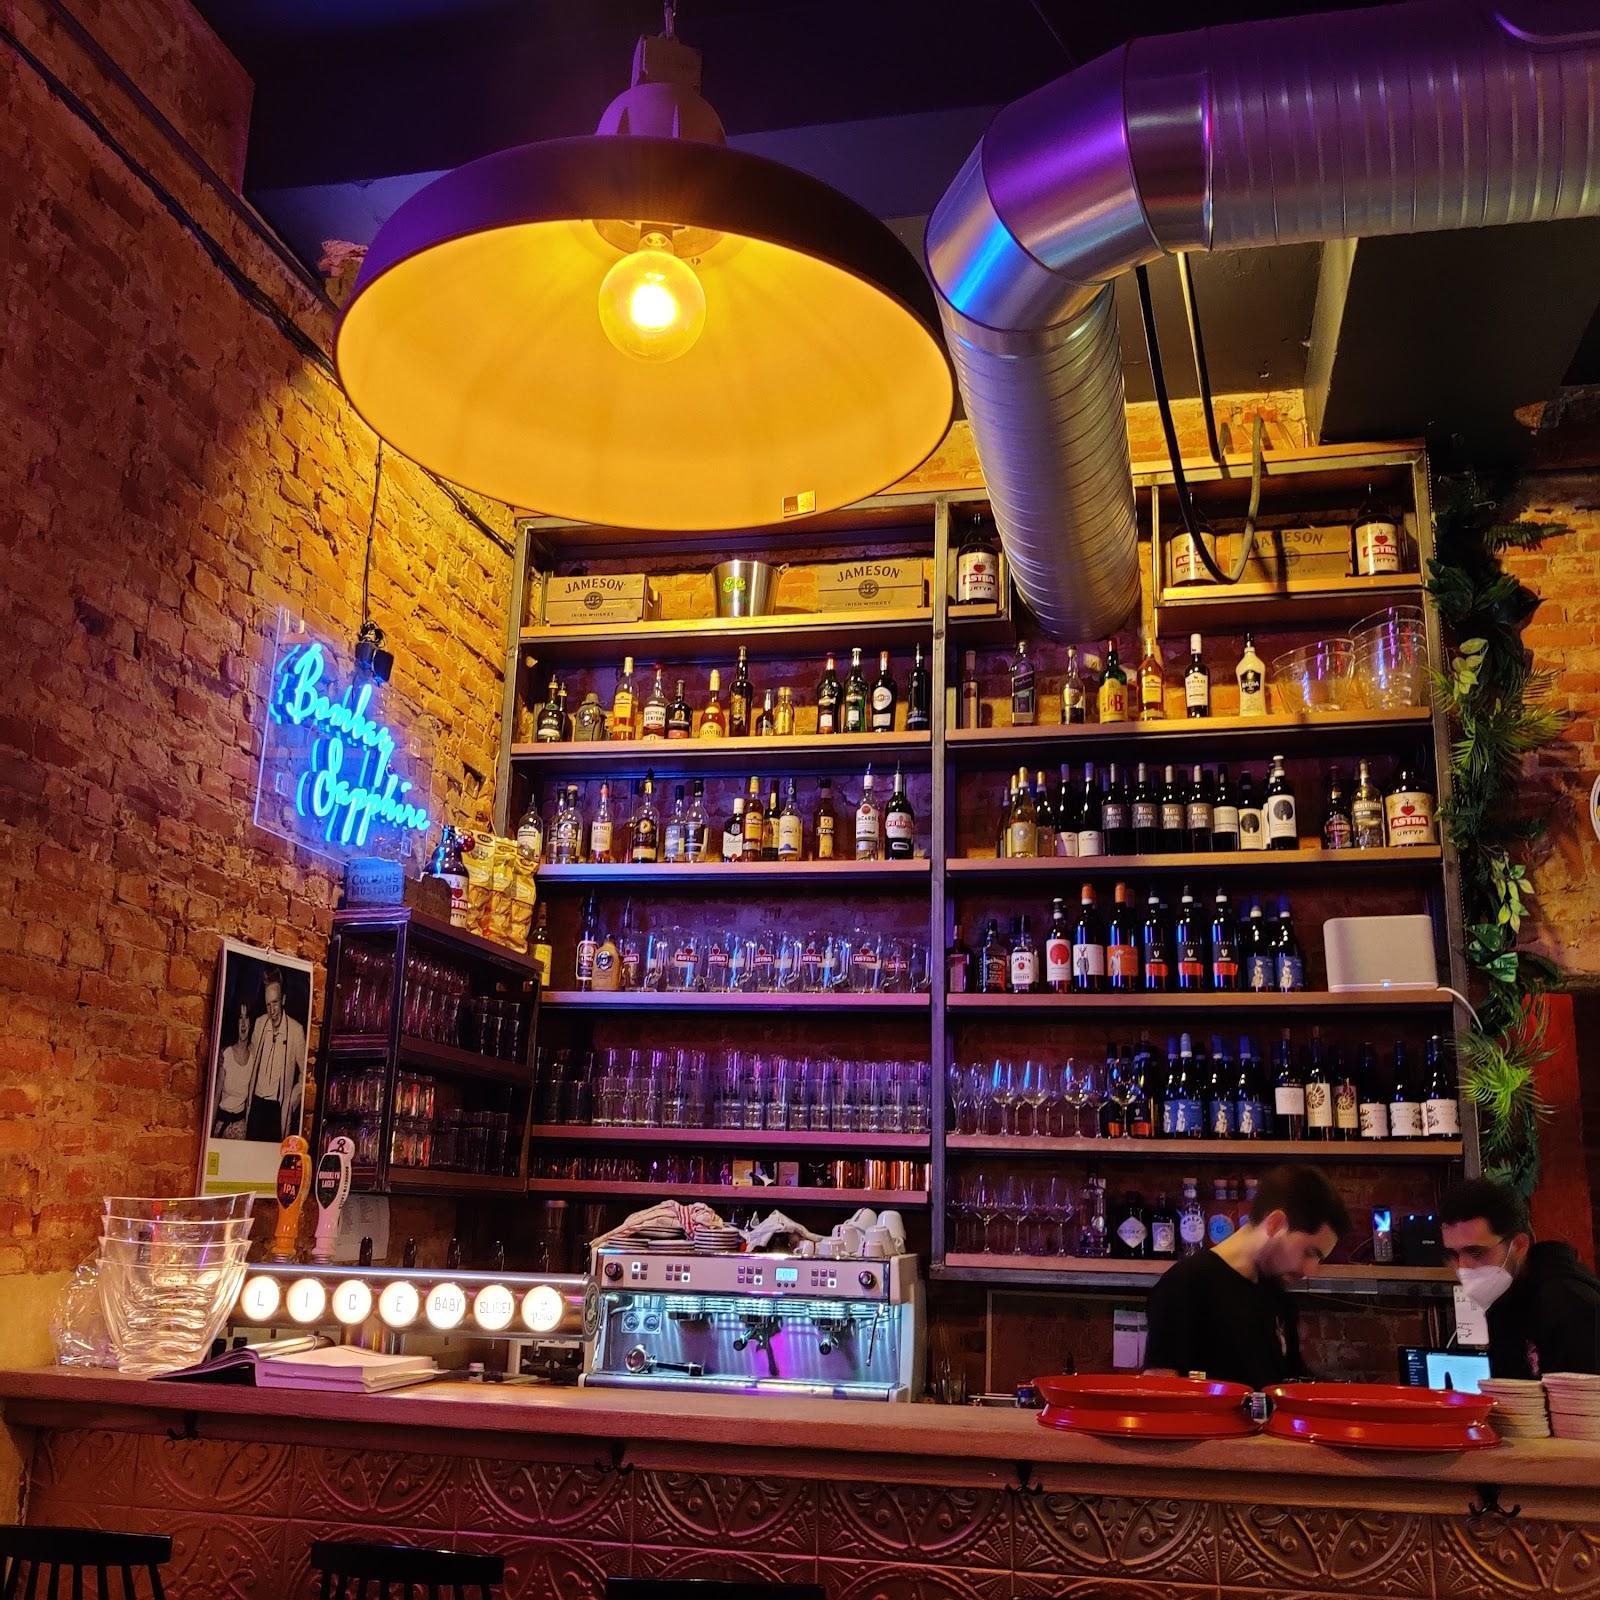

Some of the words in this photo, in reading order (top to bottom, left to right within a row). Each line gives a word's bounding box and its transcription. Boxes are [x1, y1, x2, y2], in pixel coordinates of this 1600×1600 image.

[837, 565, 900, 582] JAMESON
[565, 577, 624, 594] JAMESON
[313, 737, 431, 847] Sapphire
[1392, 816, 1427, 828] ASTRA
[1397, 829, 1424, 837] URTYP
[318, 1171, 340, 1180] BROOKLYN
[283, 1183, 296, 1196] IPA
[321, 1180, 335, 1189] LAGER
[434, 1296, 462, 1313] BABY
